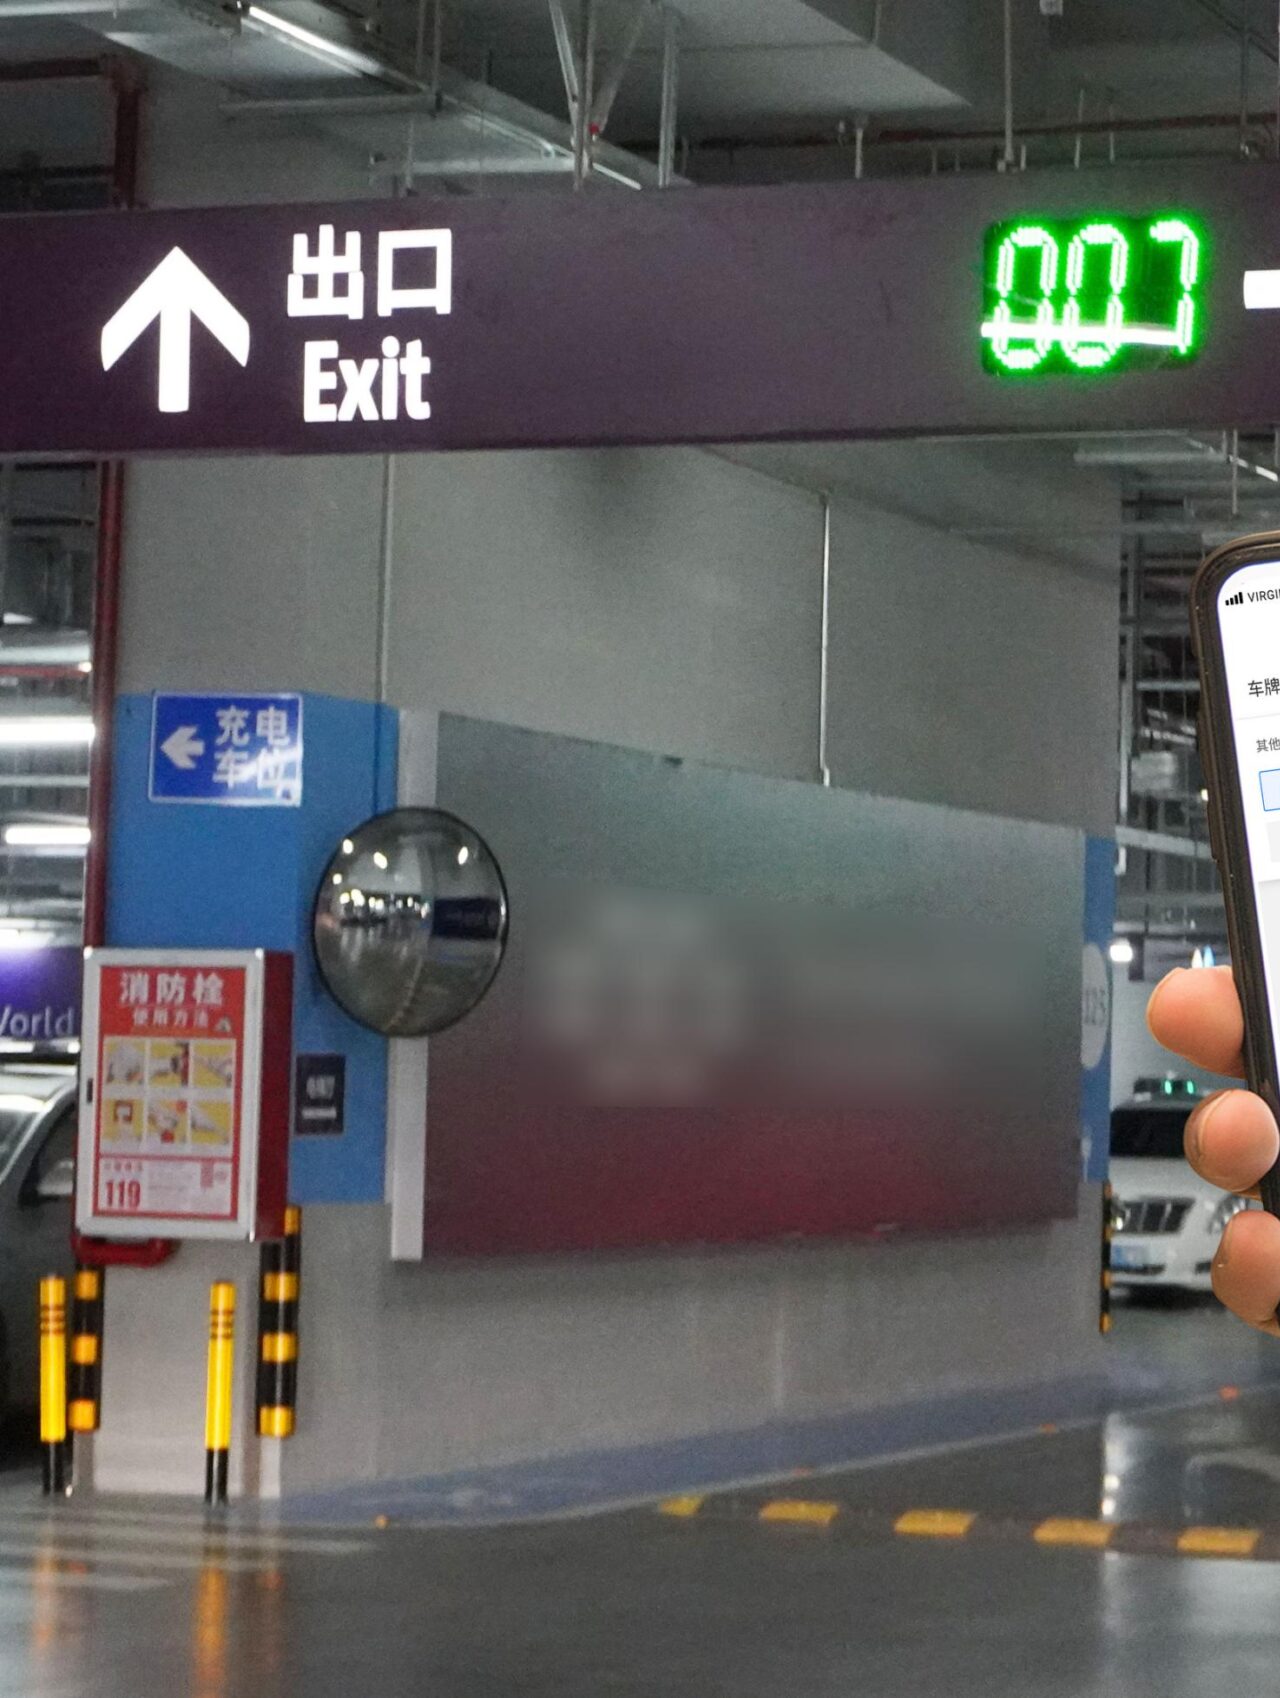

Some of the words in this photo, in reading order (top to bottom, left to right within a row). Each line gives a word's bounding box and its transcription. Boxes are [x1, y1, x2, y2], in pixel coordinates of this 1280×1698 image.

[287, 224, 452, 320] 出口
[992, 219, 1199, 369] 007
[303, 335, 431, 423] Exit
[215, 704, 291, 746] 充电
[119, 971, 225, 1007] 消防栓
[105, 1179, 142, 1209] 119
